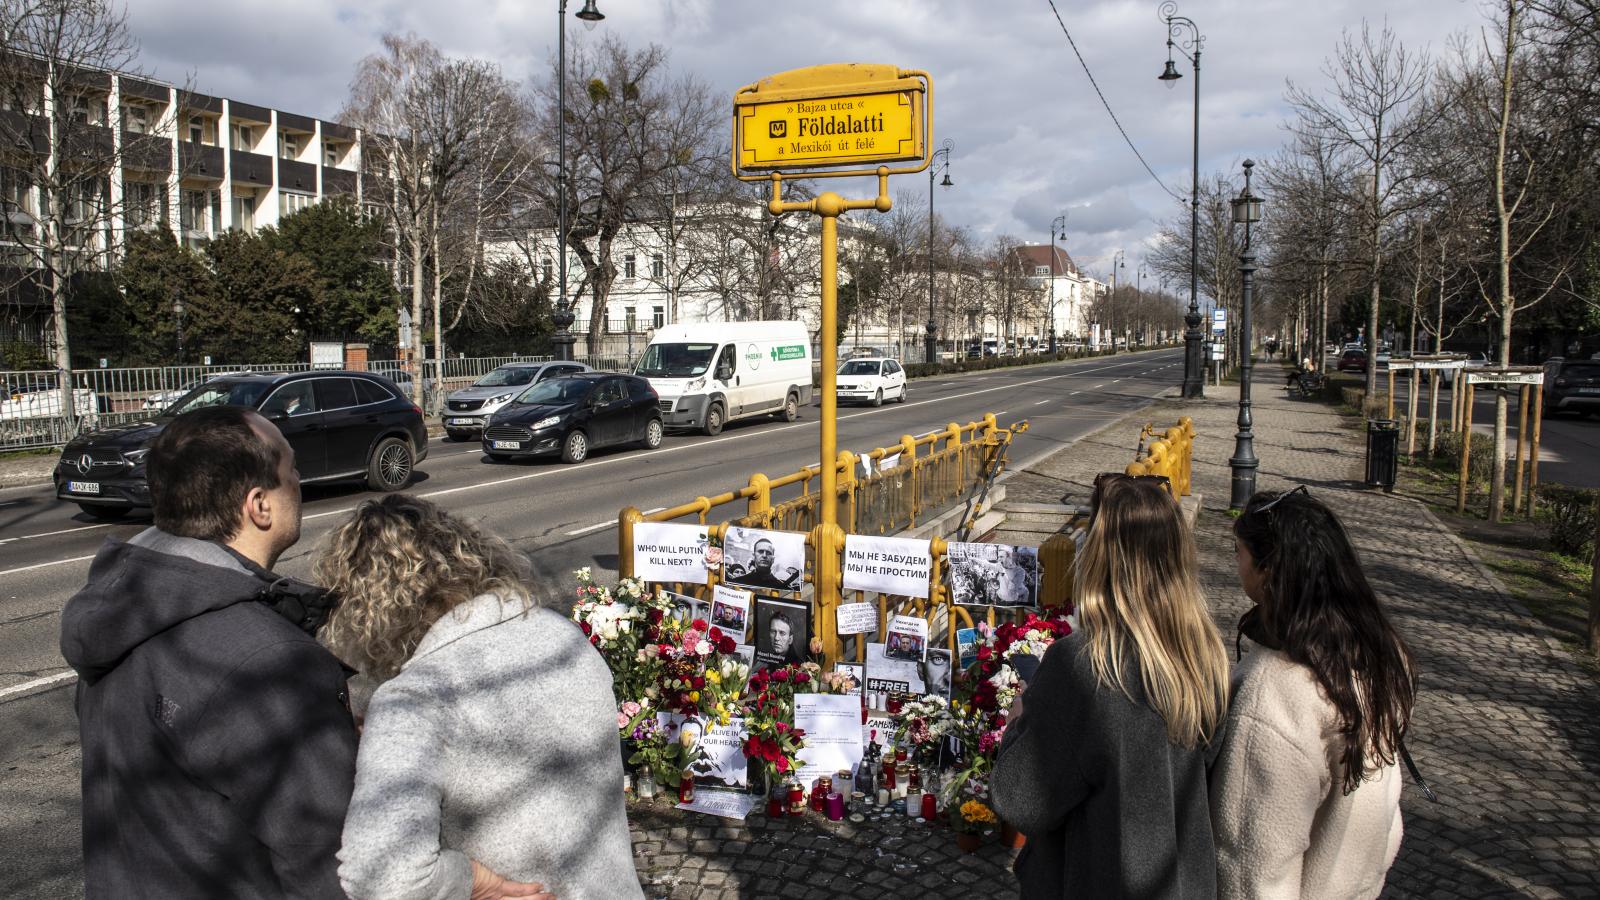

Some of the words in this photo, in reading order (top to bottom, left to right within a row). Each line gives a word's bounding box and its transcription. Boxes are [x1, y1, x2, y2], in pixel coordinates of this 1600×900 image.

[797, 103, 826, 115] Bajza
[830, 102, 853, 112] utca
[798, 112, 884, 137] Földalatti
[778, 146, 785, 155] a
[790, 140, 832, 154] Mexikói
[838, 140, 850, 151] út
[855, 137, 875, 150] felé
[637, 544, 657, 553] WHO
[658, 544, 678, 554] WILL
[679, 546, 704, 555] PUTIN
[649, 557, 666, 566] KILL
[667, 557, 693, 566] NEXT?
[848, 550, 865, 560] МЫ
[867, 552, 879, 561] НЕ
[881, 553, 927, 566] ЗАБУДЕМ
[847, 563, 863, 572] МЫ
[865, 565, 877, 574] НЕ
[879, 567, 927, 579] ПРОСТИМ
[869, 680, 908, 692] #FREE
[711, 729, 729, 737] ALIVE
